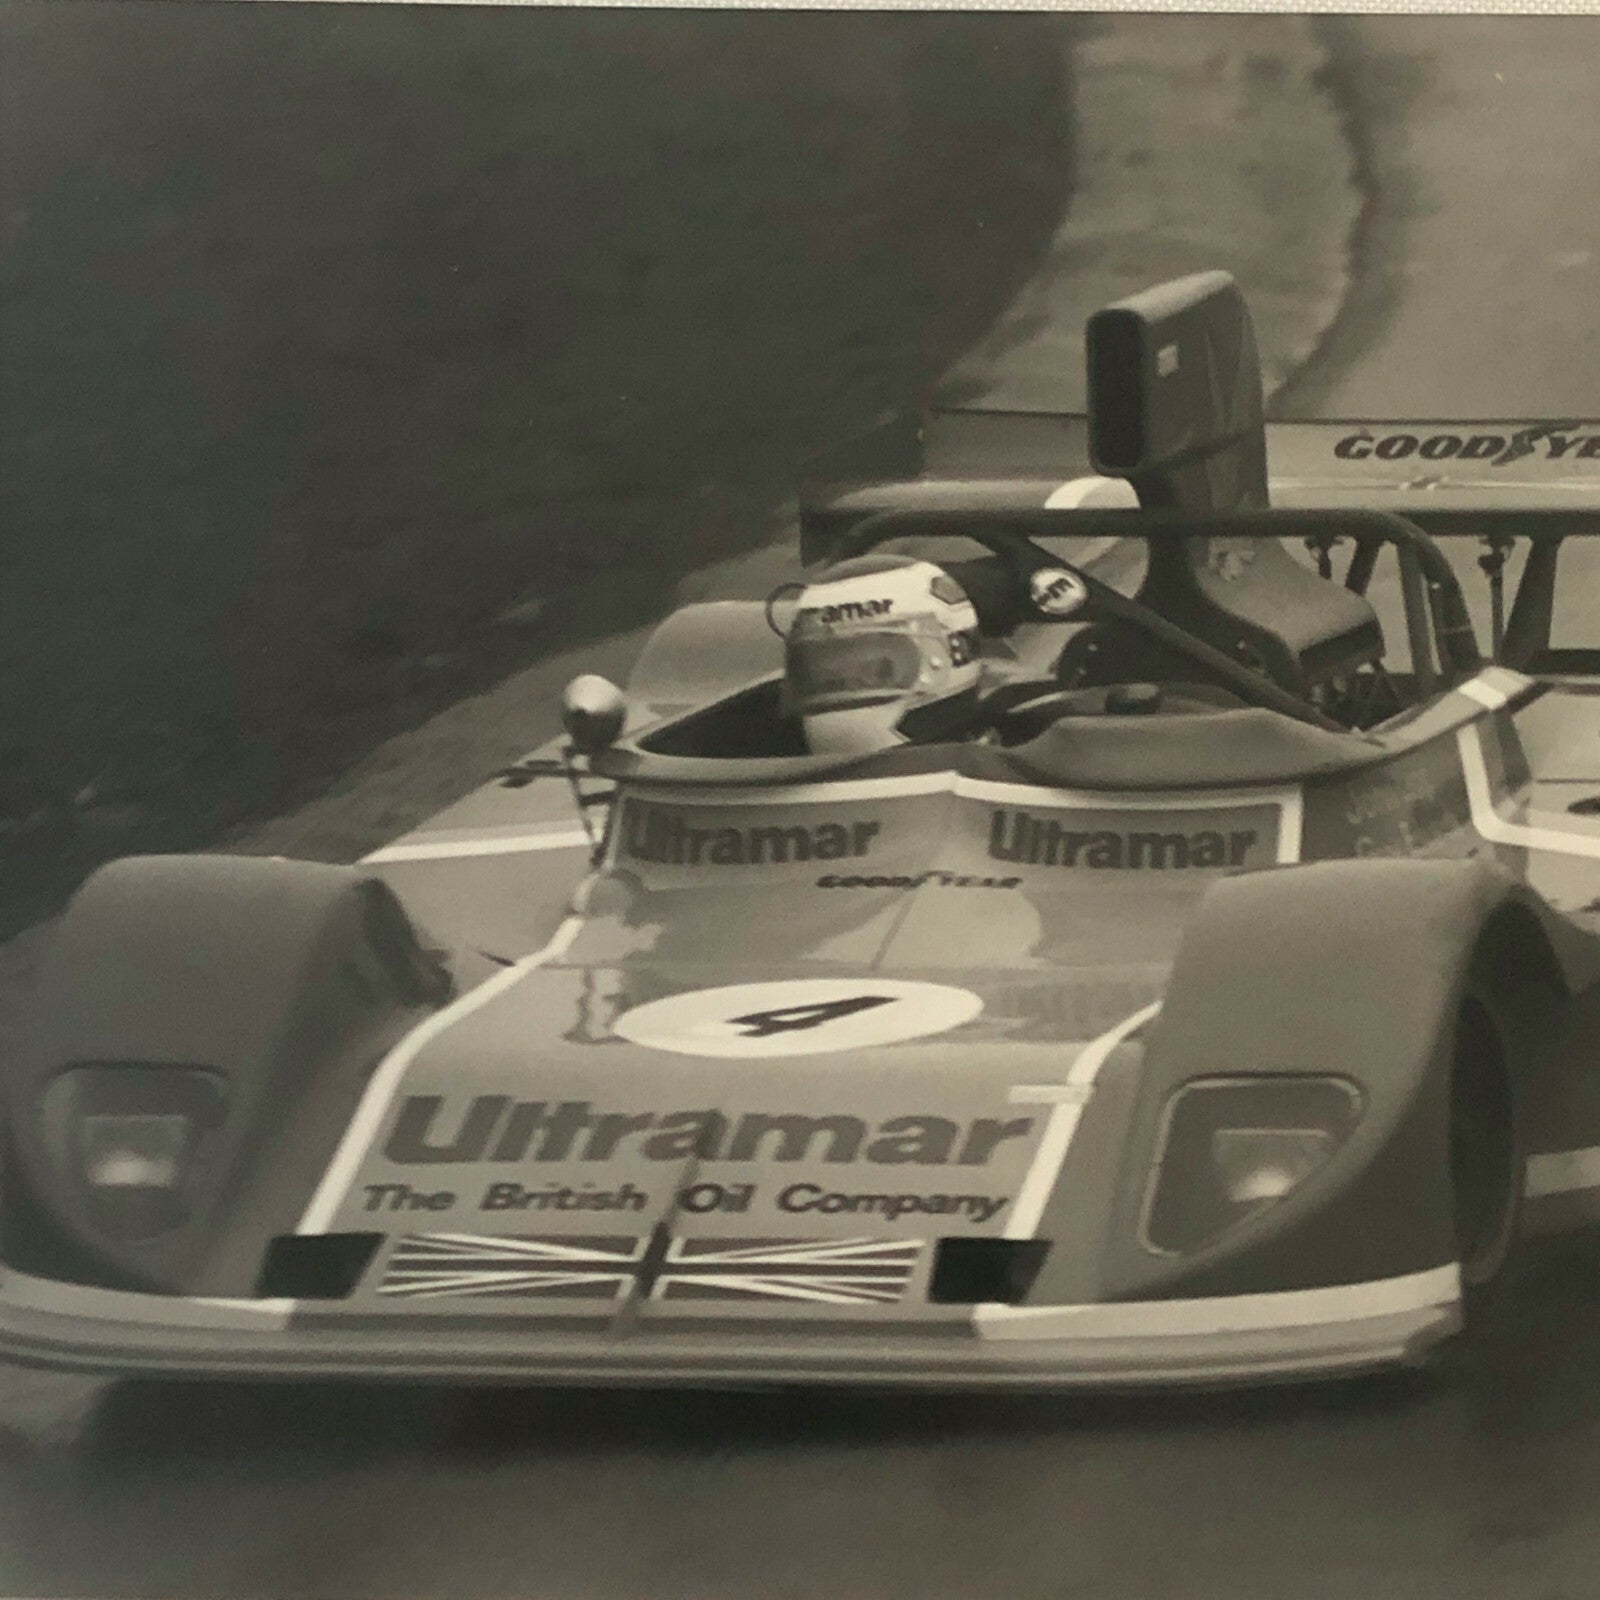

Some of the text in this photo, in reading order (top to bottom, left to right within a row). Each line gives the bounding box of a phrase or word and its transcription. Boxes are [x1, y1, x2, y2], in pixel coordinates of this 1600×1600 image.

[623, 801, 881, 865] Ultramar
[988, 809, 1258, 869] Ultramar
[724, 995, 902, 1038] 4
[384, 1094, 1036, 1167] Ultramar
[364, 1182, 1009, 1223] The British Oil Company
